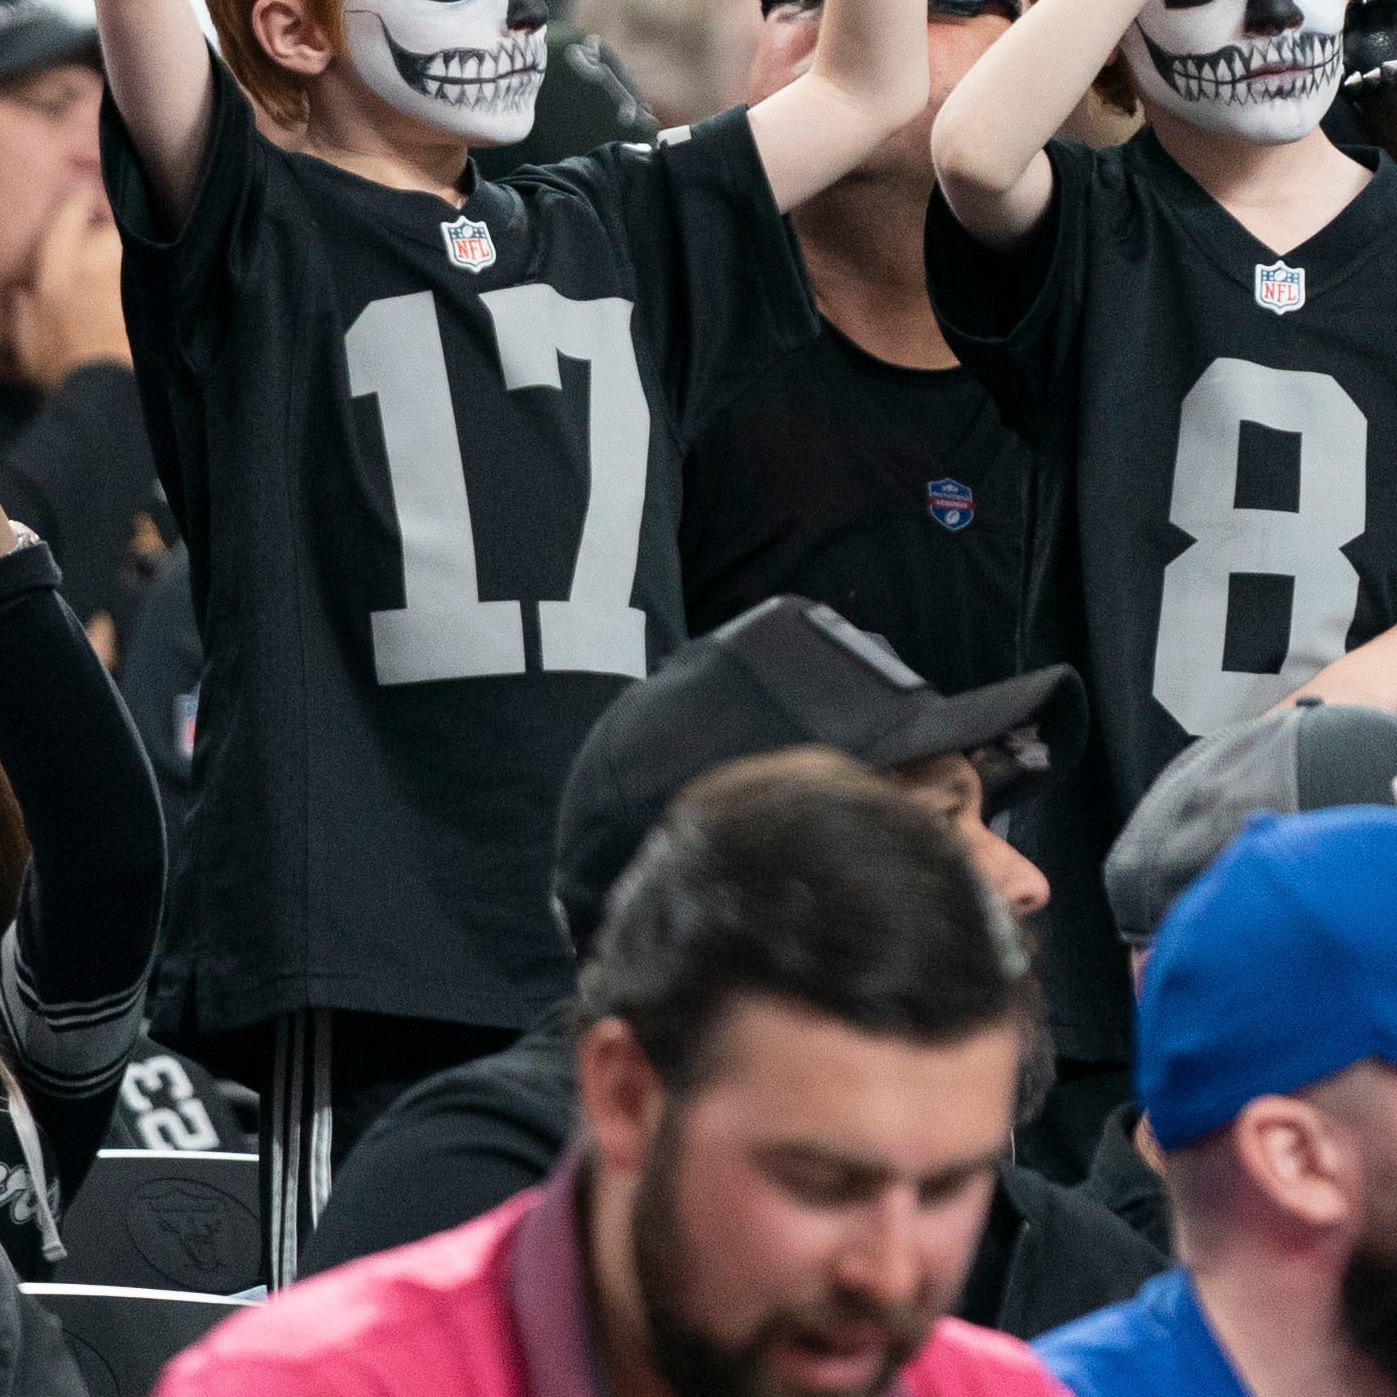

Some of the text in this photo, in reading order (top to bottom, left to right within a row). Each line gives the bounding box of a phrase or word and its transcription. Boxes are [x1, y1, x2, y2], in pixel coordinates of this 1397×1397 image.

[454, 239, 491, 261] NFL
[1263, 282, 1297, 303] NFL
[344, 283, 651, 687] 17
[1152, 356, 1368, 738] 8
[120, 1054, 220, 1151] 23
